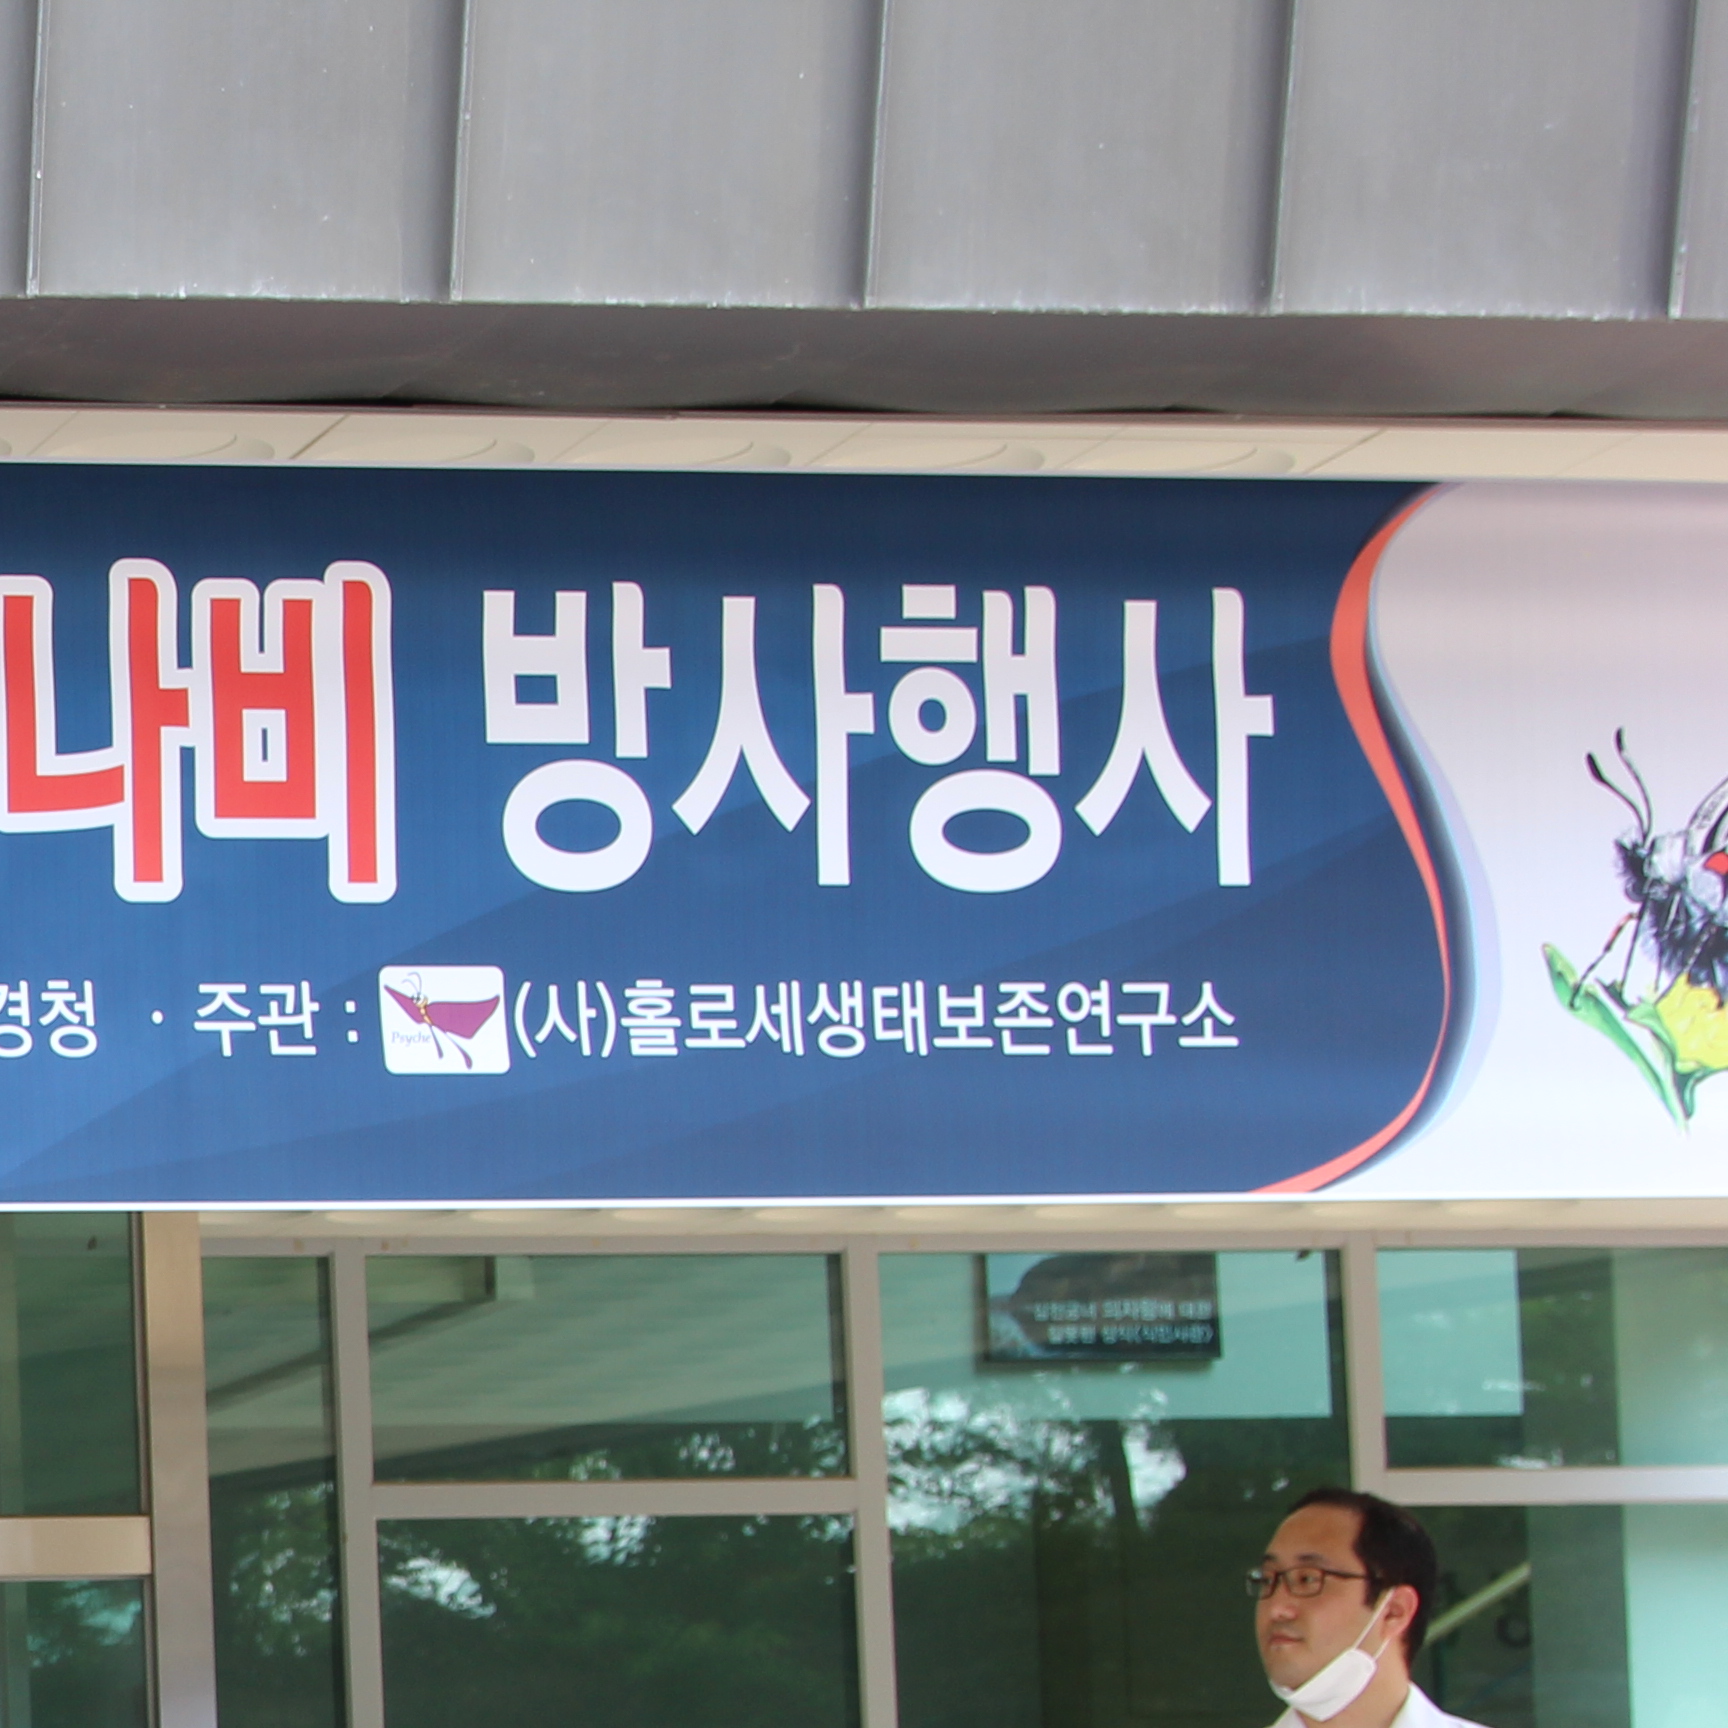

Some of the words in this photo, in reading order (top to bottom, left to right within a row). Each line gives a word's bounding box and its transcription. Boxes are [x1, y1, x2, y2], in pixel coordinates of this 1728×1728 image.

[484, 582, 1274, 891] 방사행사
[195, 981, 319, 1056] 주관
[515, 980, 1238, 1057] (사)홀로세생태보존연구소
